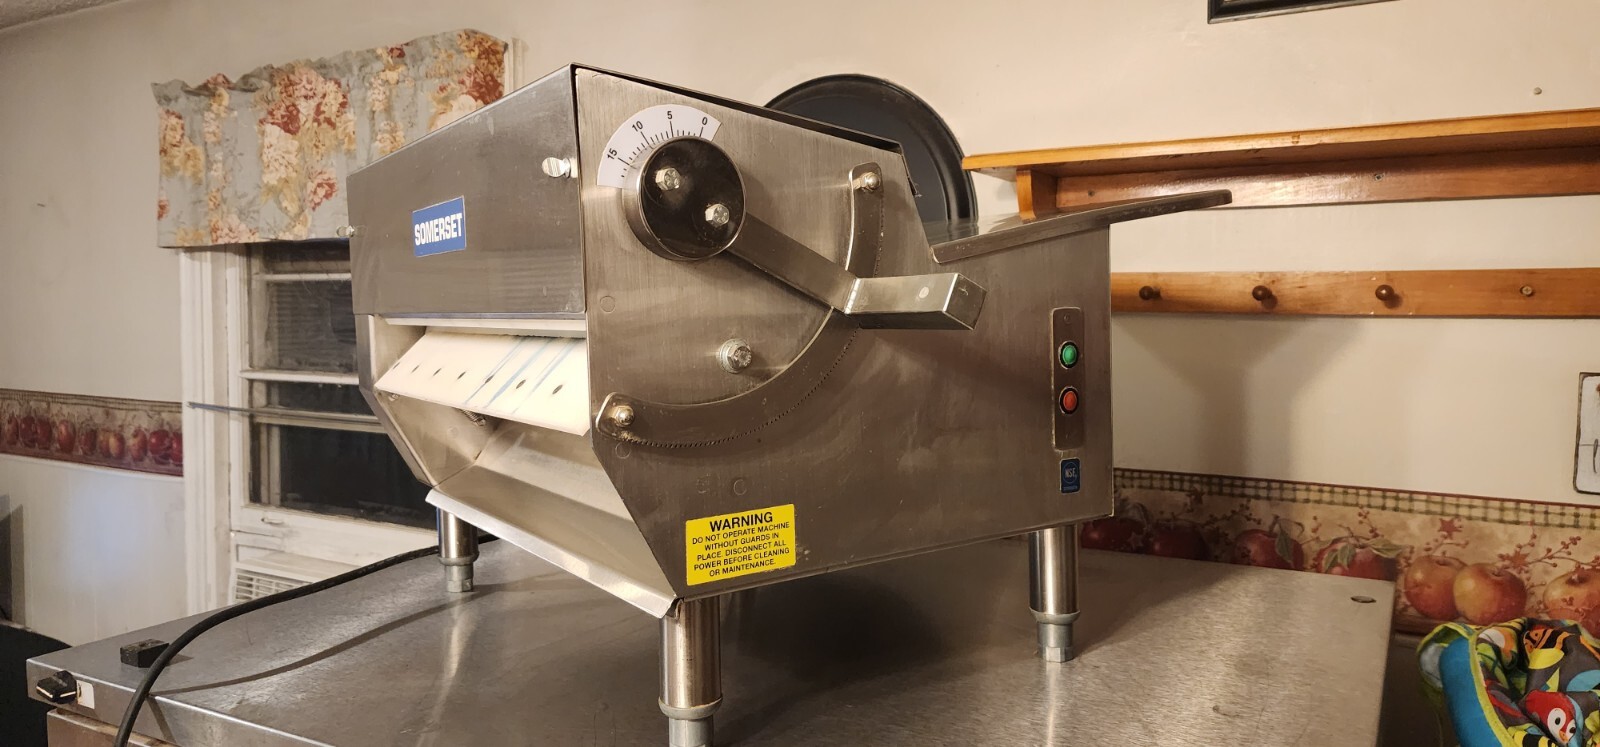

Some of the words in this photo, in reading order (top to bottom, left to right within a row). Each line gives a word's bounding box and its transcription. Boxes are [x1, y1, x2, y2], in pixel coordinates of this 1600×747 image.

[667, 110, 673, 120] 5
[701, 116, 708, 126] 0
[632, 120, 643, 132] 10
[607, 148, 618, 160] 15
[414, 212, 463, 246] SOMERSET
[709, 511, 773, 532] WARNING
[692, 536, 703, 545] DO
[705, 533, 720, 543] NOT
[722, 527, 756, 539] OPERATE
[757, 521, 790, 533] MACHINE
[704, 539, 739, 551] WITHOUT
[740, 533, 771, 545] GUARDS
[725, 541, 772, 556] DISCONNECT
[773, 539, 787, 547] ALL
[694, 559, 722, 571] POWER
[723, 553, 753, 566] BEFORE
[754, 547, 790, 560] CLEANING
[709, 569, 720, 577] OR
[722, 558, 776, 575] MAINTENANCE.
